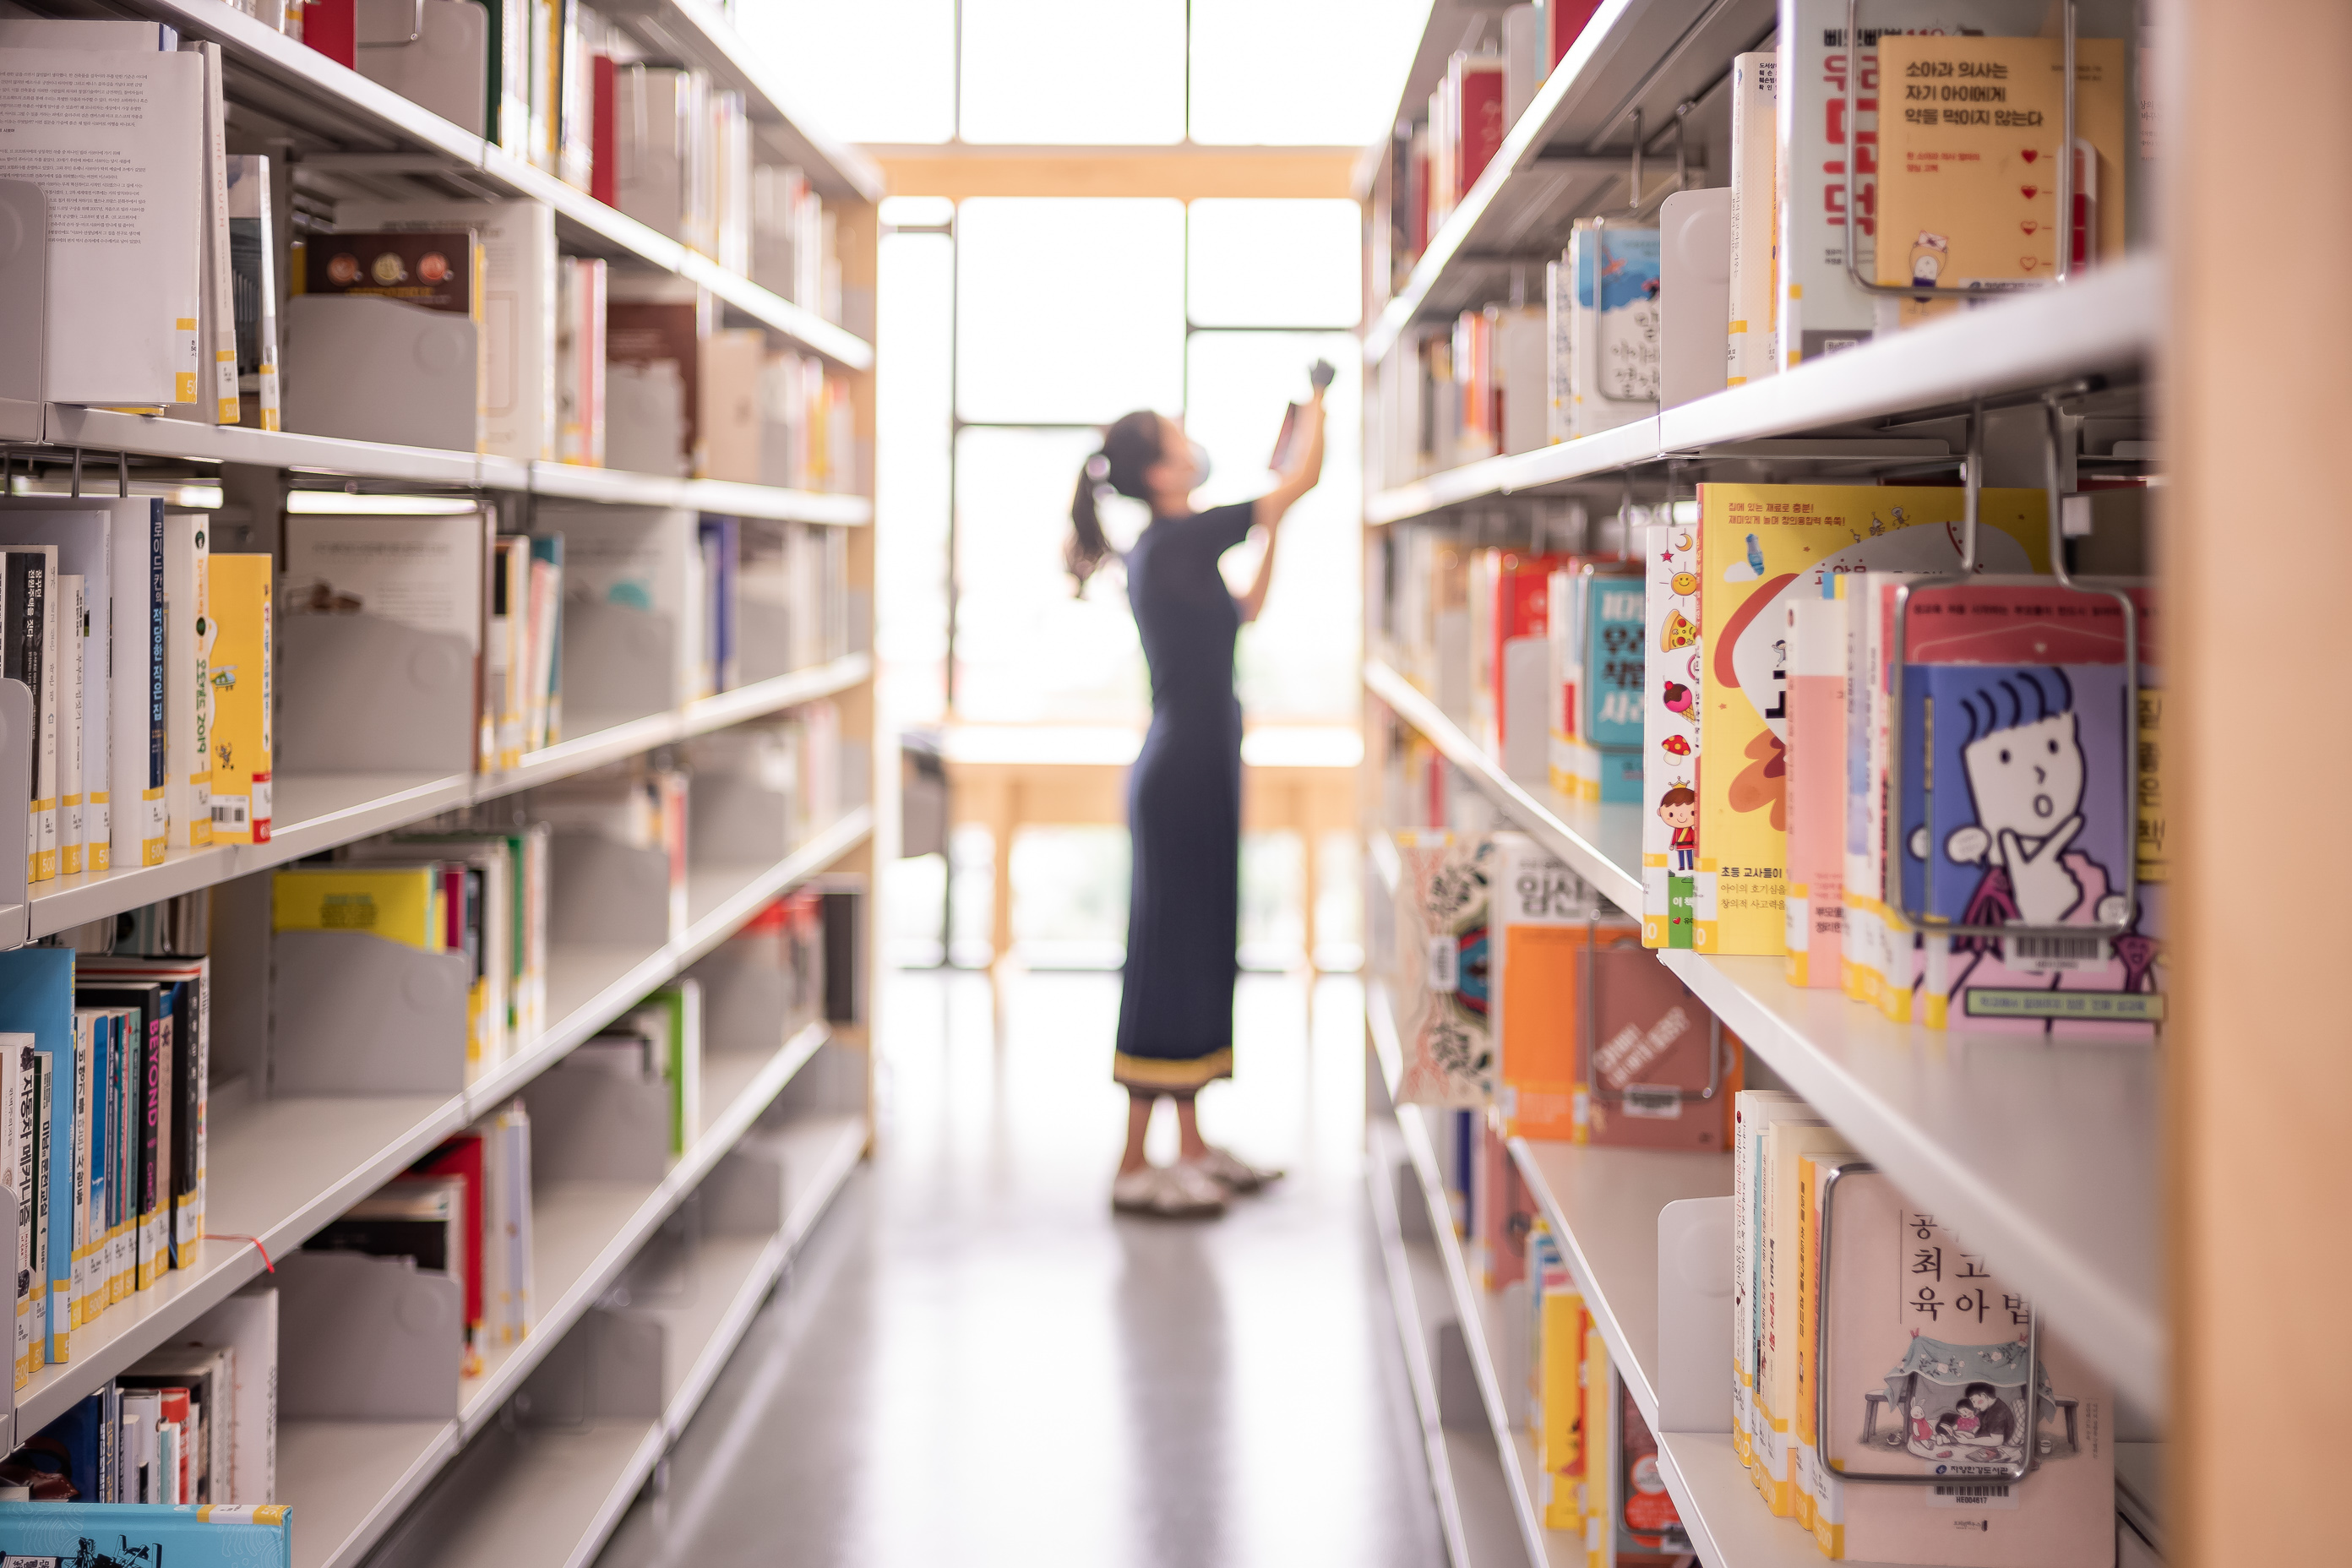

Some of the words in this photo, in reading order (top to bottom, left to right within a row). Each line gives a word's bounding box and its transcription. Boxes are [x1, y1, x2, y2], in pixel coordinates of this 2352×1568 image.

[1906, 61, 1953, 79] 소아과
[1958, 61, 2008, 79] 의사는
[1906, 84, 1936, 102] 자기
[1941, 85, 2006, 103] 아이에게
[1905, 108, 1939, 125] 약을
[1942, 109, 1990, 126] 먹이지
[1995, 110, 2044, 127] 않는다
[216, 170, 226, 228] TOUCH
[1729, 503, 1745, 512] 집에
[1747, 503, 1762, 512] 있는
[1766, 503, 1789, 513] 재료로
[1793, 504, 1814, 513] 충분!
[1729, 515, 1761, 525] 재미있게
[153, 522, 163, 570] 로이드
[27, 569, 35, 616] 전원주택을
[153, 573, 163, 603] 칸의
[26, 619, 35, 639] 짓다
[153, 607, 163, 662] 적당한
[153, 664, 163, 700] 작은
[196, 659, 207, 711] 오토캐드
[153, 703, 163, 721] 집
[196, 713, 207, 754] 2019
[41, 857, 55, 873] 500
[1720, 866, 1740, 878] 초등
[1743, 867, 1783, 879] 교사들이
[1720, 884, 1747, 894] 아이의
[1750, 884, 1786, 896] 호기심을
[1673, 896, 1682, 908] 이
[1720, 899, 1747, 909] 창의적
[1750, 899, 1785, 911] 사고력을
[148, 1019, 160, 1128] BEYOND
[20, 1075, 33, 1139] 자동차
[41, 1120, 51, 1157] 미남의
[19, 1146, 32, 1228] 메커니즘
[41, 1158, 50, 1218] 운전교실
[15, 1361, 28, 1381] 500
[1951, 1465, 2008, 1475] 자양한강도서관
